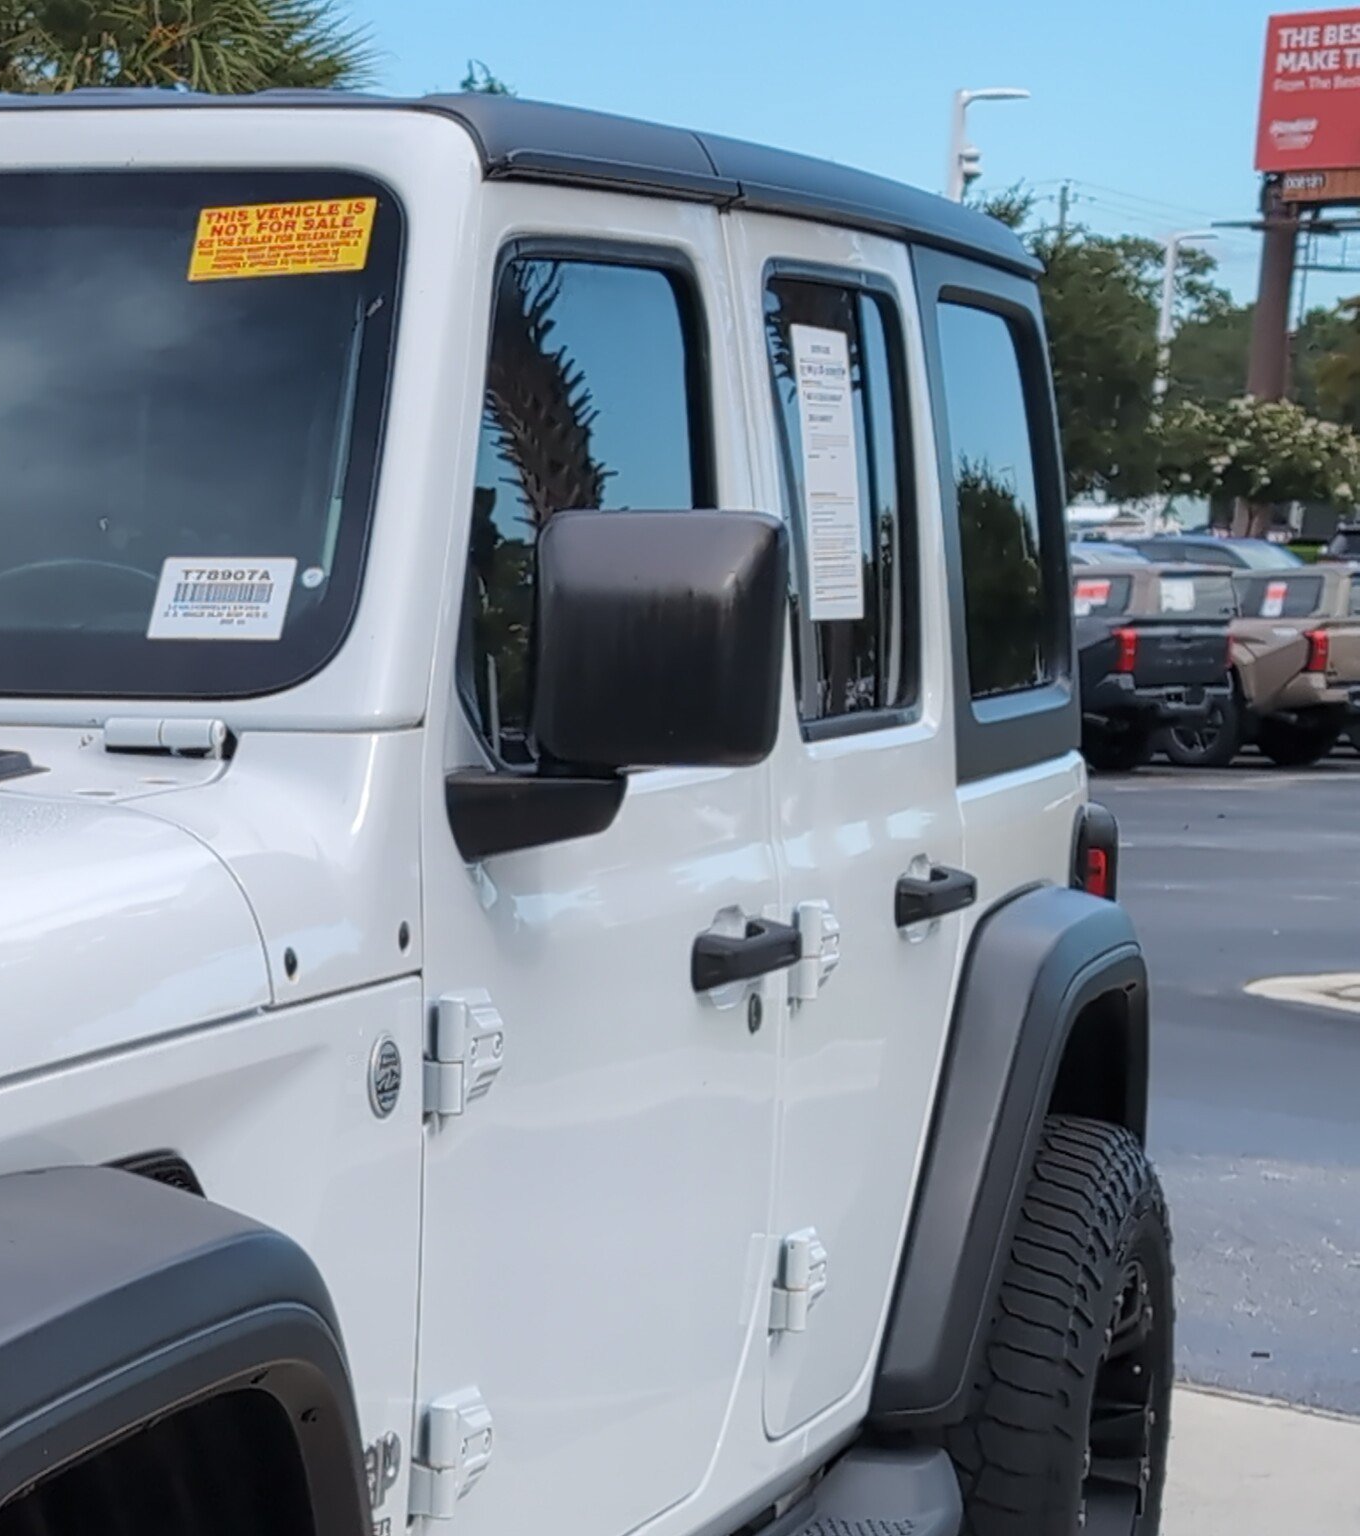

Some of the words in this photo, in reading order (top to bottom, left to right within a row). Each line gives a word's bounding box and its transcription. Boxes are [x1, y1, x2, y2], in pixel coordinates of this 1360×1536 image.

[1278, 26, 1321, 48] THE
[1276, 50, 1340, 73] MAKE
[205, 209, 248, 224] THIS
[256, 203, 341, 220] VEHICLE
[347, 201, 366, 215] IS
[210, 223, 251, 238] NOT
[256, 219, 297, 234] FOR
[302, 216, 355, 231] SALE
[182, 569, 271, 581] T78907A
